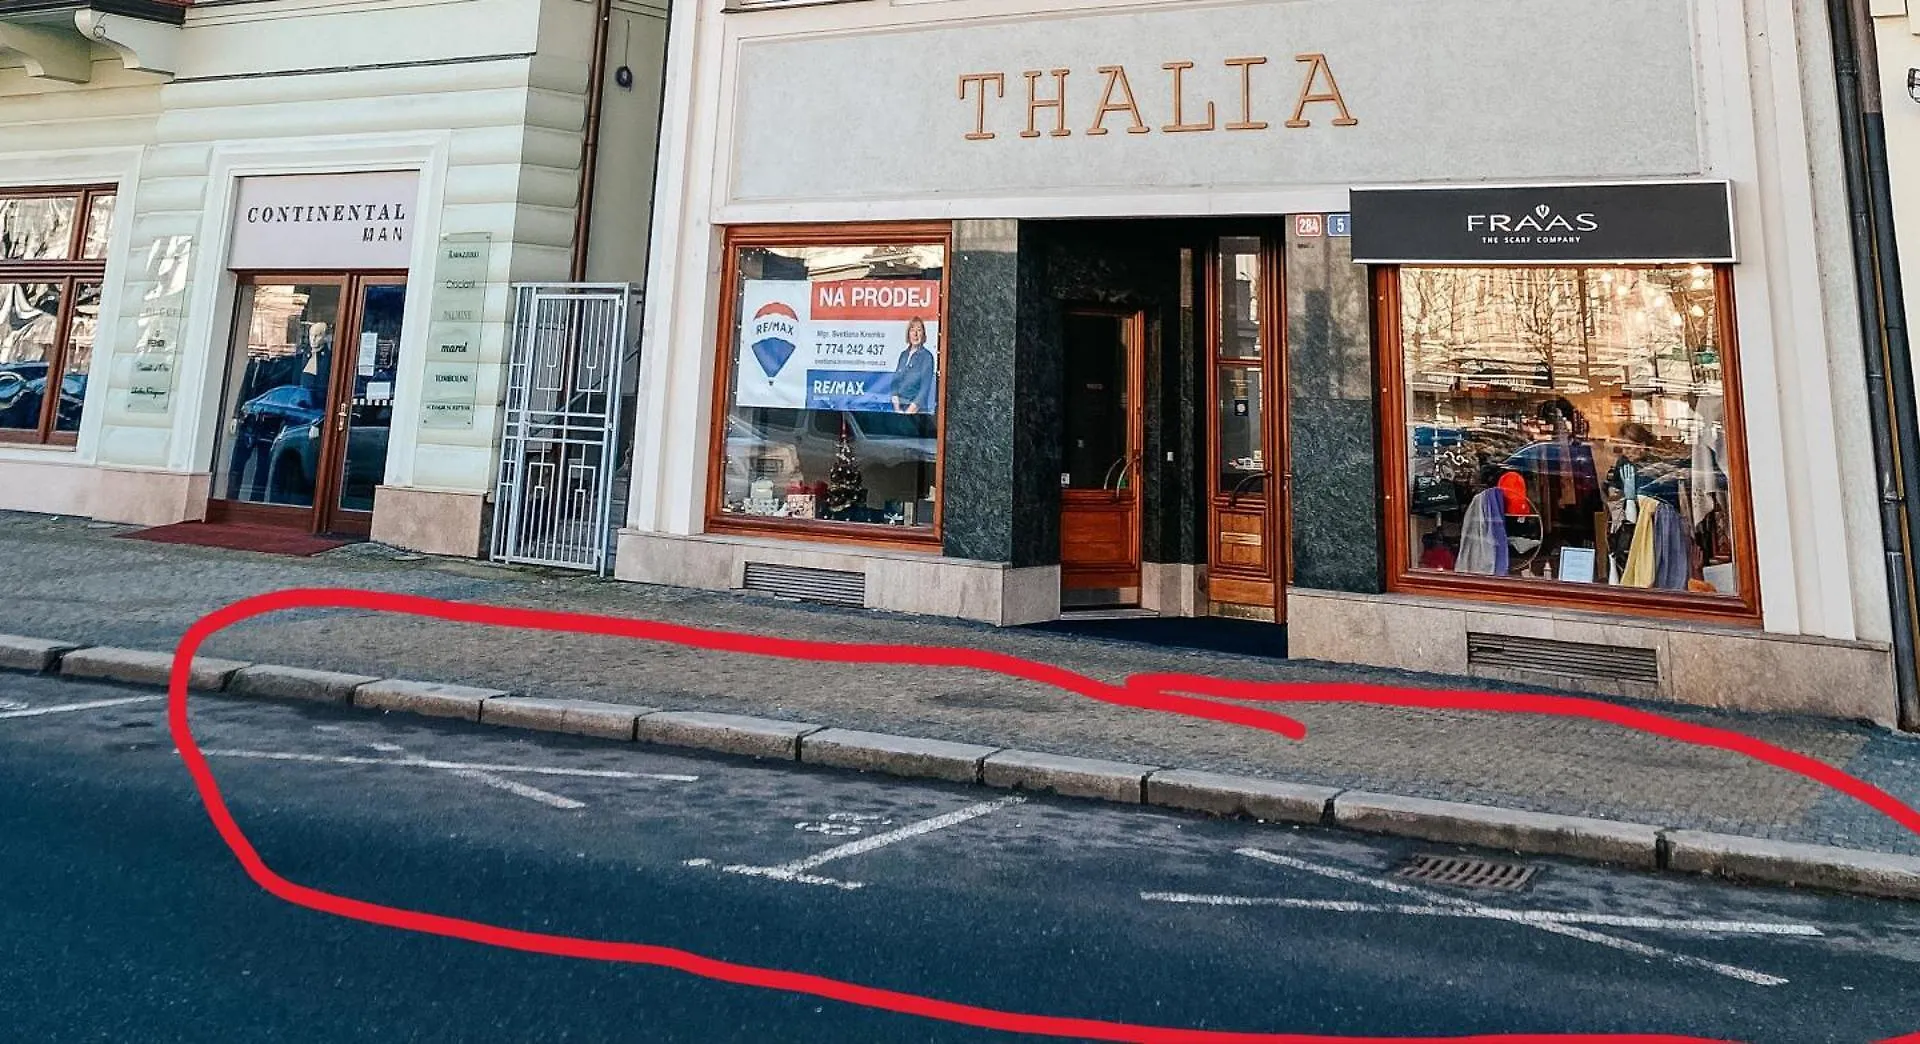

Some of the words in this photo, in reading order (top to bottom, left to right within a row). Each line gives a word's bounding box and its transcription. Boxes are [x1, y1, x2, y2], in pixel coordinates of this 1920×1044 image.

[958, 52, 1358, 140] THALIA
[247, 203, 406, 223] CONTINENTAL
[1299, 218, 1319, 233] 284
[1336, 217, 1345, 233] 5
[1467, 213, 1599, 231] FRAAS
[362, 226, 404, 242] MAN
[819, 287, 846, 307] NA
[851, 286, 932, 308] PRODEJ
[756, 322, 794, 336] RE/MAX
[816, 343, 822, 354] T
[825, 343, 843, 354] 774
[846, 344, 864, 355] 242
[866, 344, 885, 355] 437
[813, 380, 865, 396] RE/MAX
